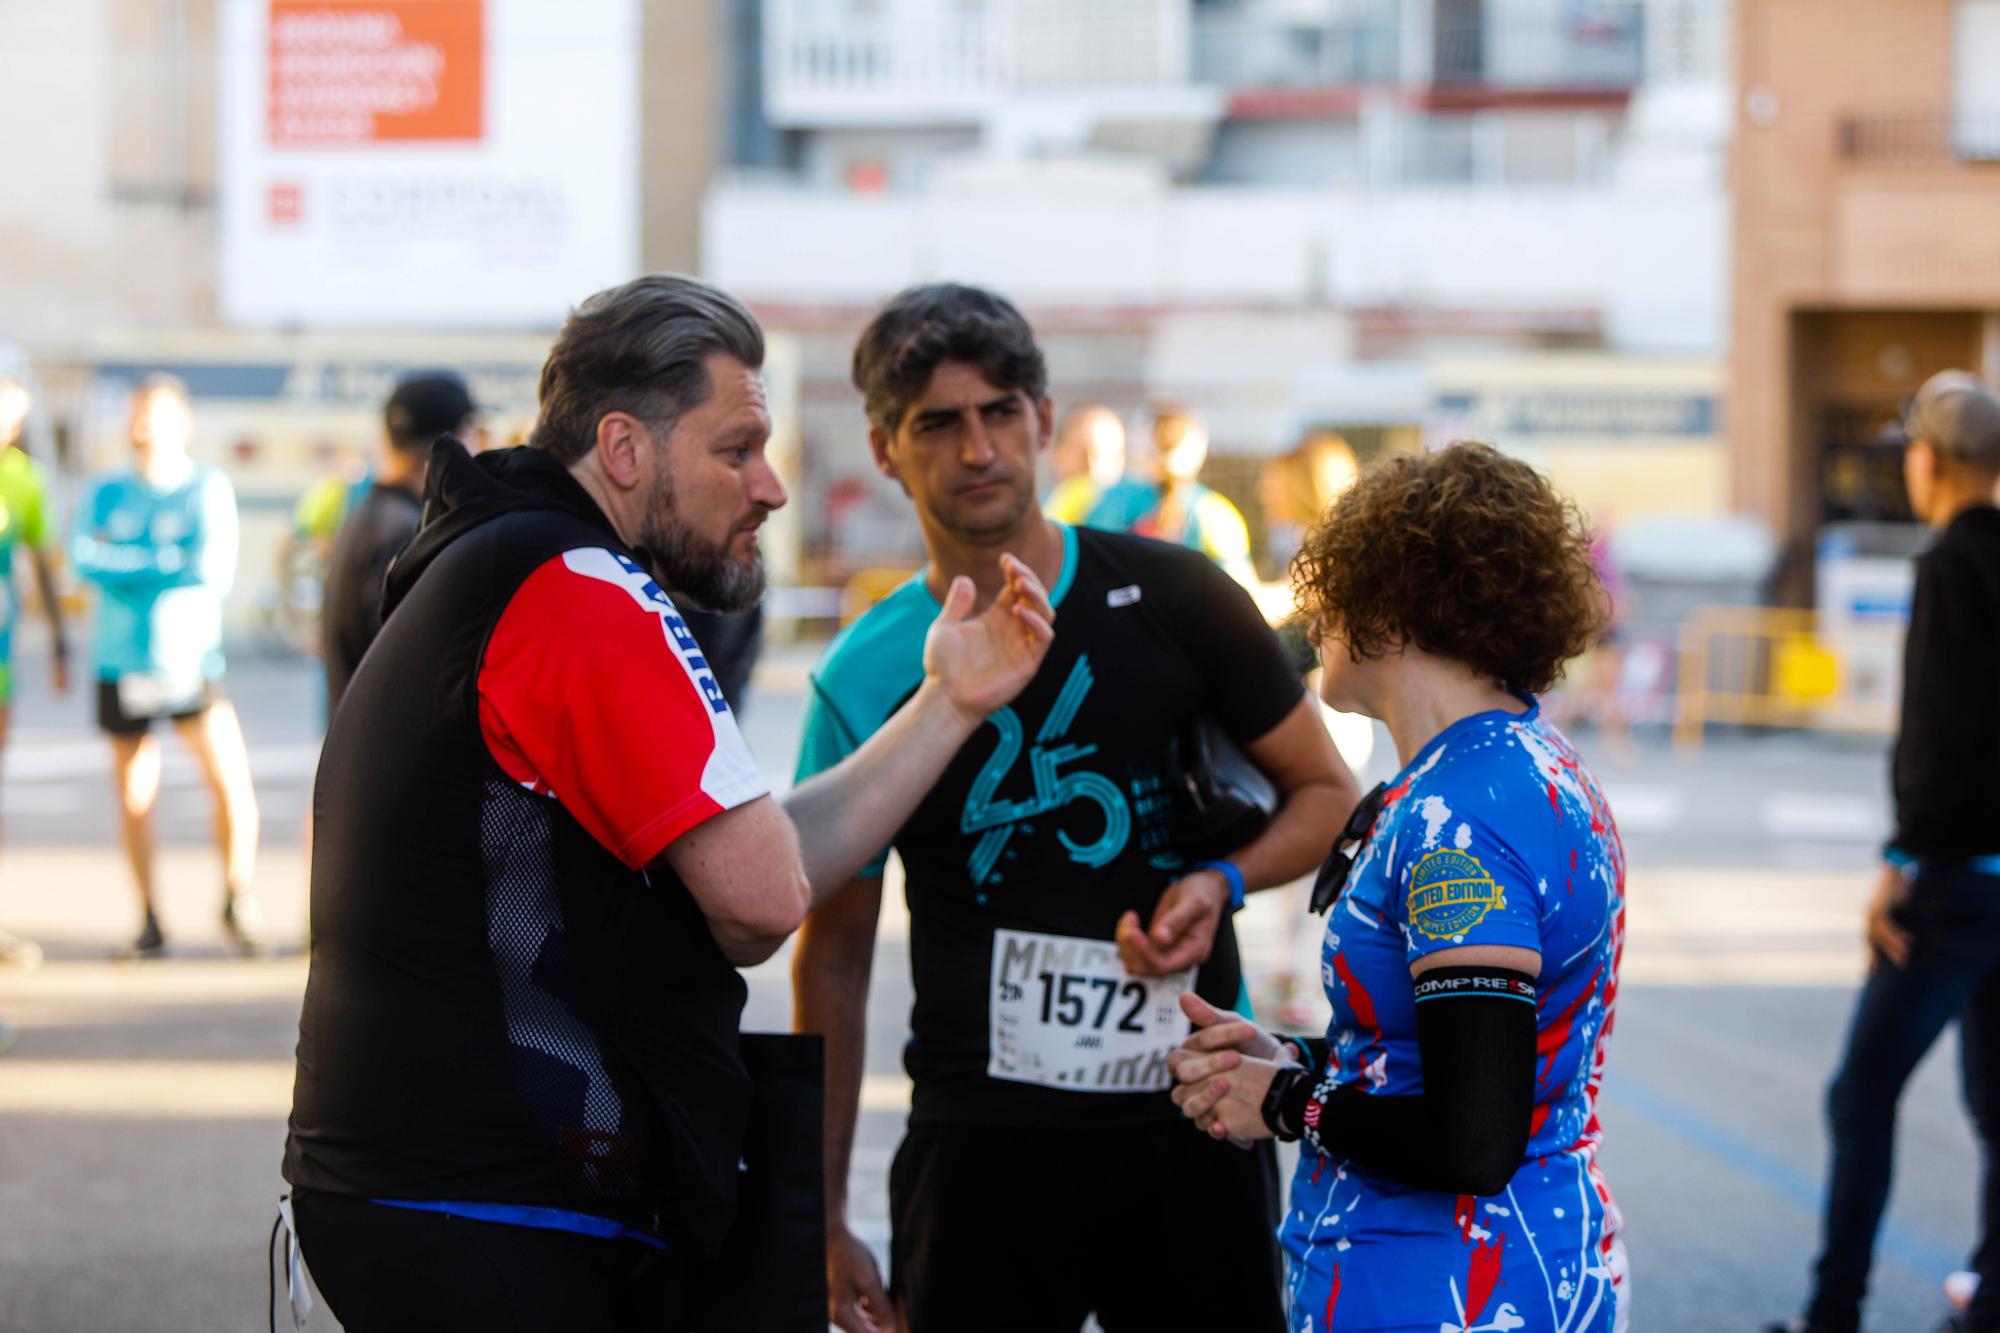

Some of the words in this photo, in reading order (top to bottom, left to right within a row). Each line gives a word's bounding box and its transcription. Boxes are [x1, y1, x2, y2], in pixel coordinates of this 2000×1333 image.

[1445, 854, 1478, 876] EDITION
[1447, 882, 1493, 900] EDITION
[1038, 971, 1148, 1034] 1572
